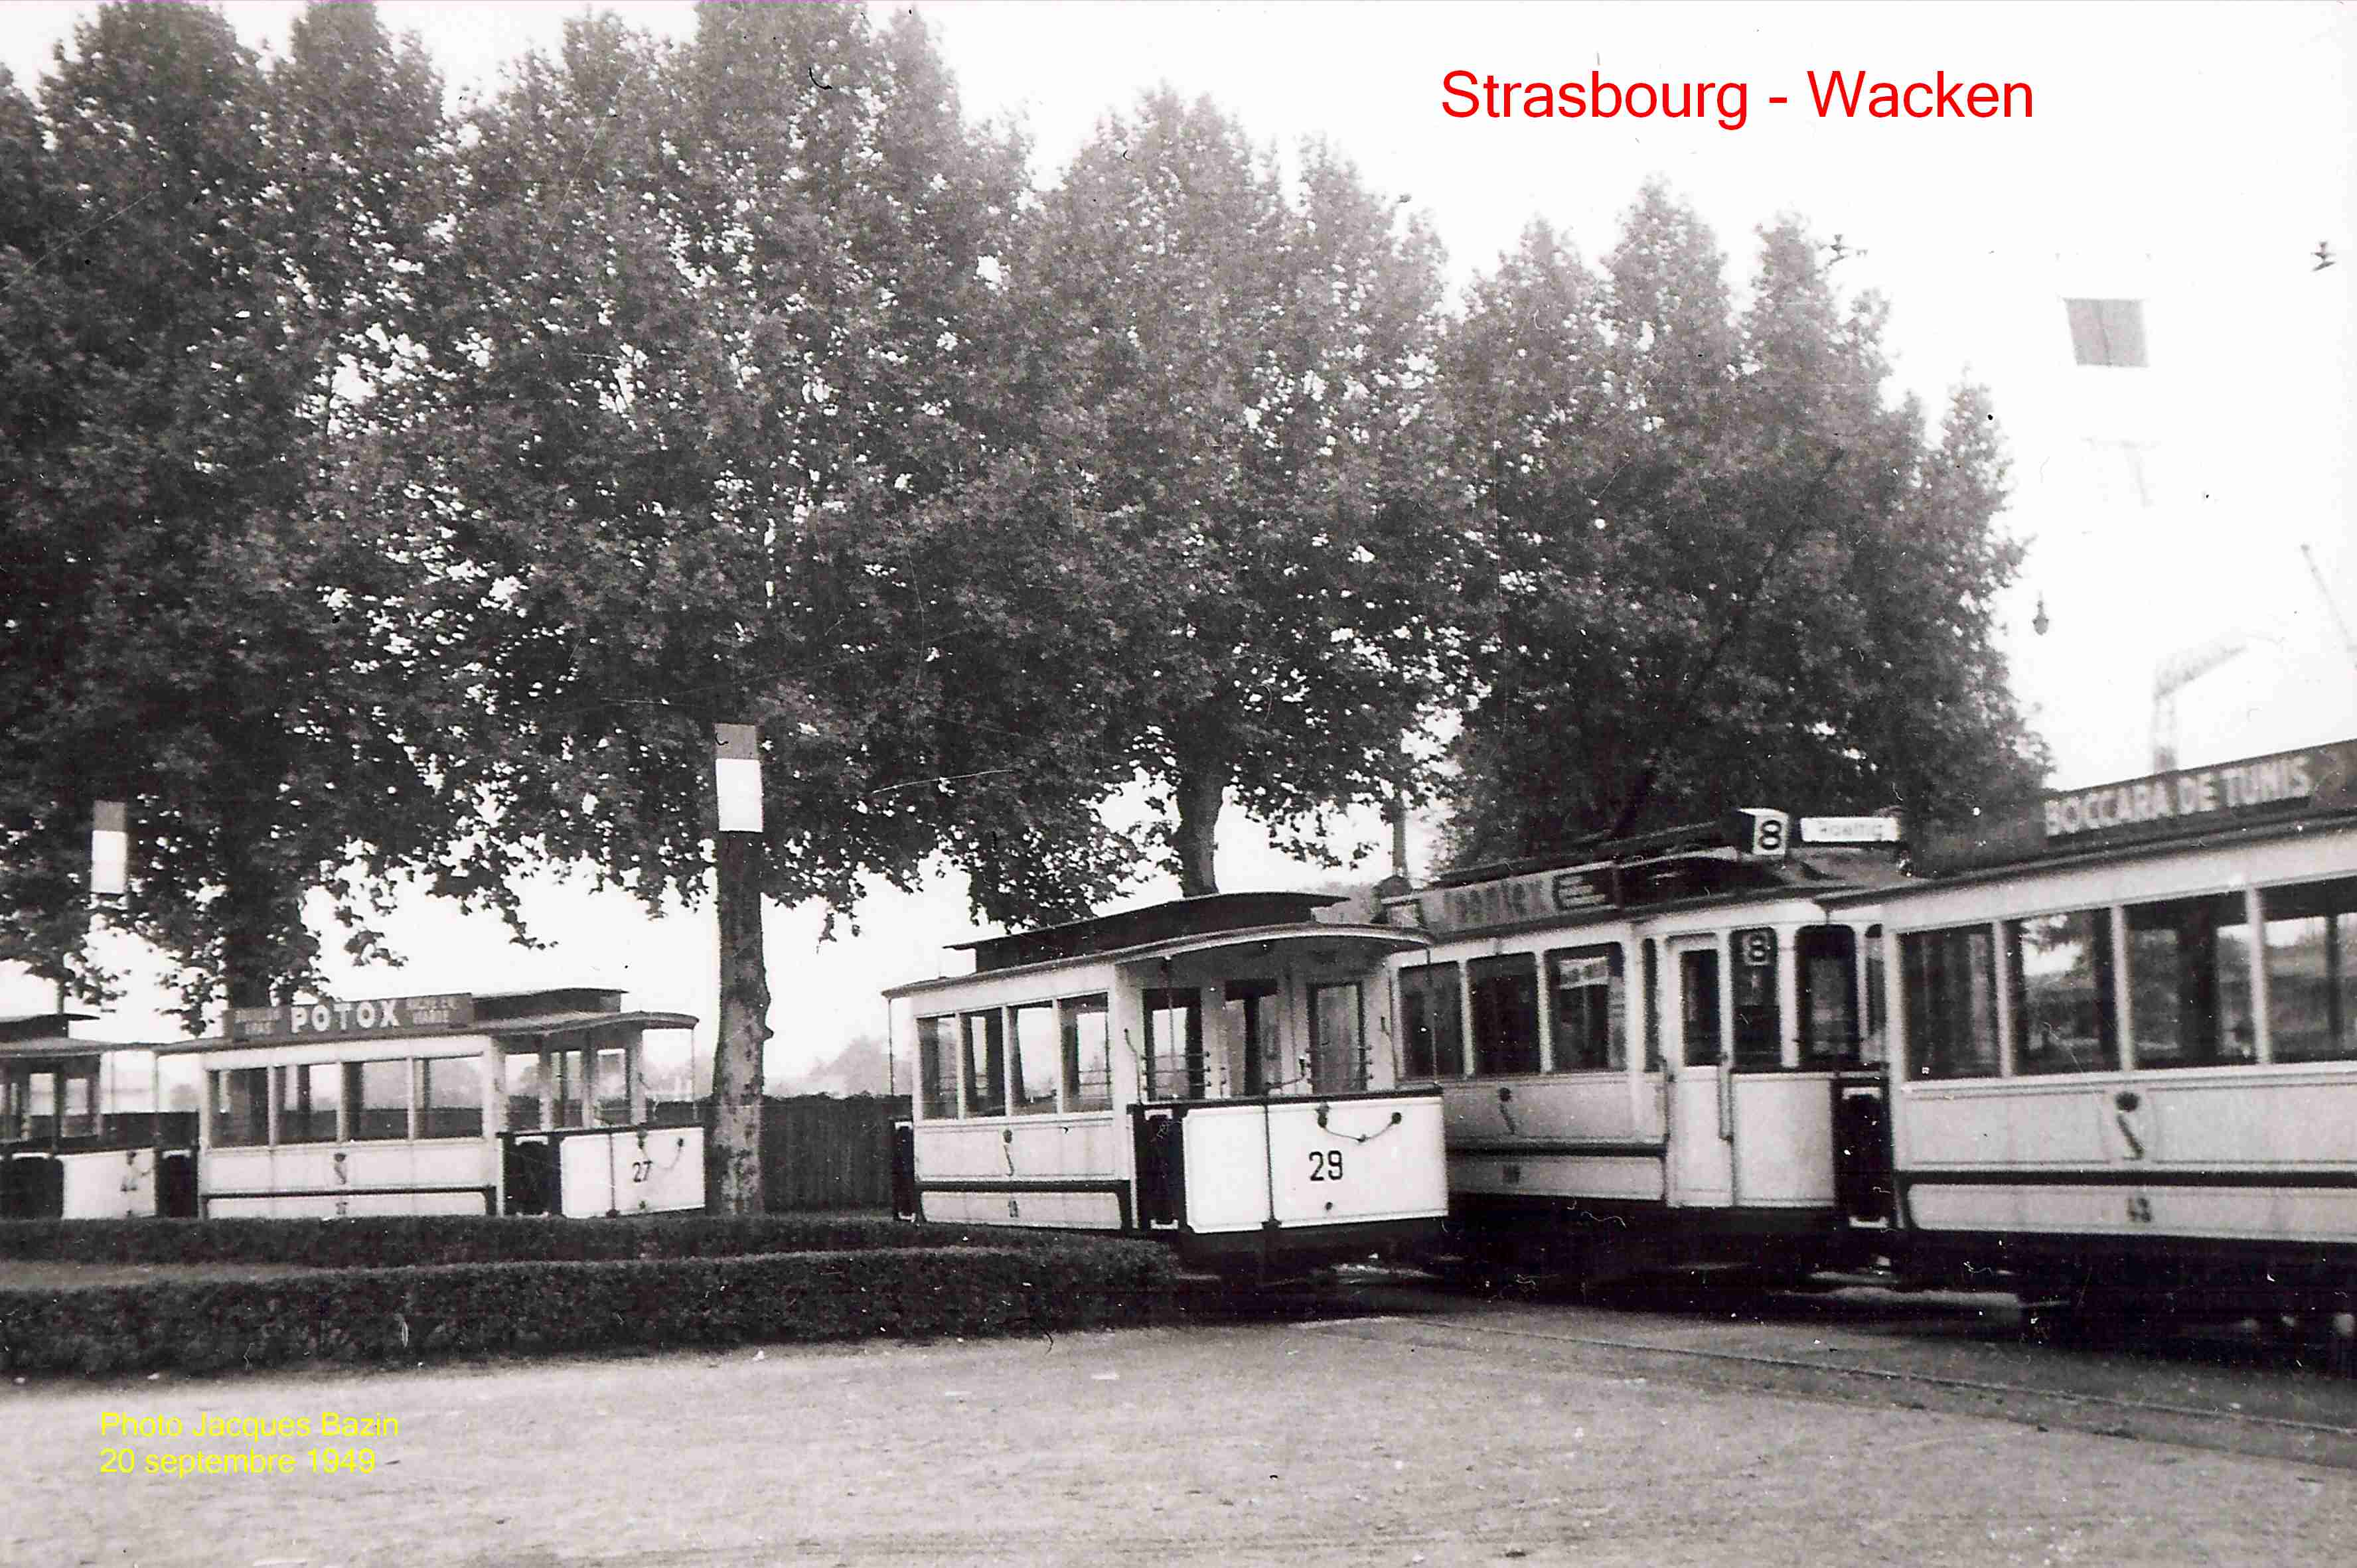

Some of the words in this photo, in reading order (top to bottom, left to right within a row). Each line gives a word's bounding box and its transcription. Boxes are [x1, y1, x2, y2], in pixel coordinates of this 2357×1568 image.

[2044, 780, 2167, 837] BOCCARA
[2178, 772, 2216, 812] DE
[2220, 755, 2312, 808] TUNIS
[1758, 820, 1782, 851] 8
[290, 999, 400, 1034] POTOX
[633, 1160, 653, 1183] 27
[1309, 1150, 1343, 1181] 29
